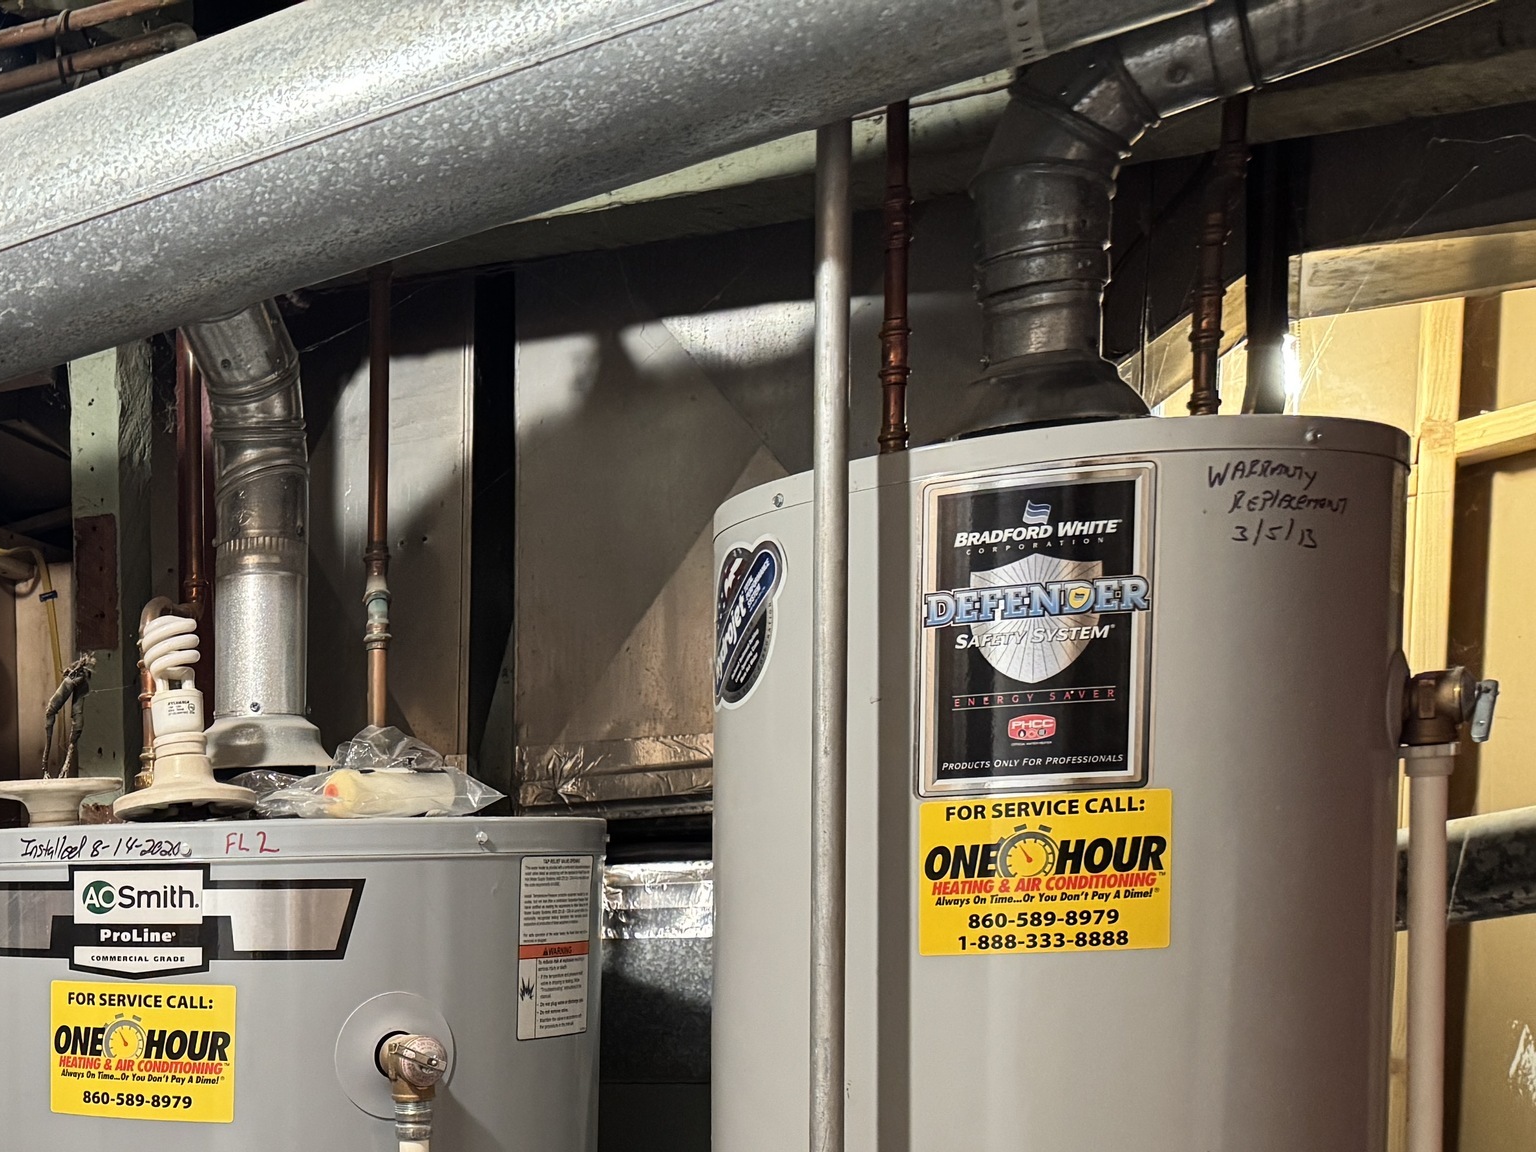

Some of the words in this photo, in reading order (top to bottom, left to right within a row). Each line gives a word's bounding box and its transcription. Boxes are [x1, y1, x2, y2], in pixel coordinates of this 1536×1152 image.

[954, 525, 1052, 548] BRADFORD
[1058, 519, 1119, 536] WHITE
[966, 536, 1104, 556] CORPORATION
[924, 575, 1150, 628] DEFENDER
[955, 631, 1027, 650] SAFETY
[1031, 625, 1109, 643] SYSTEM
[954, 693, 1034, 707] ENERGY
[1050, 689, 1115, 700] SAVER
[1011, 719, 1055, 729] PHCC
[942, 760, 990, 771] PRODUCTS
[994, 759, 1019, 768] ONLY
[1022, 757, 1042, 766] FOR
[1046, 754, 1123, 765] PROFESSIONALS
[946, 806, 986, 821] FOR
[992, 801, 1078, 818] SERVICE
[1085, 796, 1145, 813] CALL:
[20, 835, 87, 860] Installed
[225, 833, 249, 854] FL
[256, 831, 279, 854] 2
[925, 843, 999, 880] ONE
[1055, 836, 1167, 875] HOUR
[932, 879, 994, 895] HEATING
[999, 878, 1011, 893] &
[1014, 879, 1041, 892] AIR
[1046, 873, 1157, 891] CONDITIONING
[935, 896, 970, 907] Always
[973, 896, 986, 905] On
[1038, 892, 1057, 903] You
[1060, 891, 1089, 901] Don't
[1092, 891, 1111, 902] Pay
[1114, 890, 1121, 899] A
[1124, 888, 1153, 899] Dime!
[968, 909, 1119, 929] 860-589-8979
[100, 929, 173, 943] ProLine
[958, 930, 1129, 950] 1-888-333-8888
[68, 992, 95, 1006] FOR
[99, 993, 162, 1008] SERVICE
[167, 996, 213, 1009] CALL:
[55, 1025, 105, 1055] ONE
[144, 1030, 230, 1061] HOUR
[59, 1056, 101, 1069] HEATING
[104, 1059, 112, 1070] &
[115, 1059, 134, 1071] AIR
[138, 1060, 222, 1075] CONDITIONING
[61, 1069, 84, 1080] Always
[87, 1071, 96, 1079] On
[171, 1076, 186, 1085] Pay
[196, 1076, 219, 1084] Dime!
[83, 1091, 192, 1109] 860-589-8979
